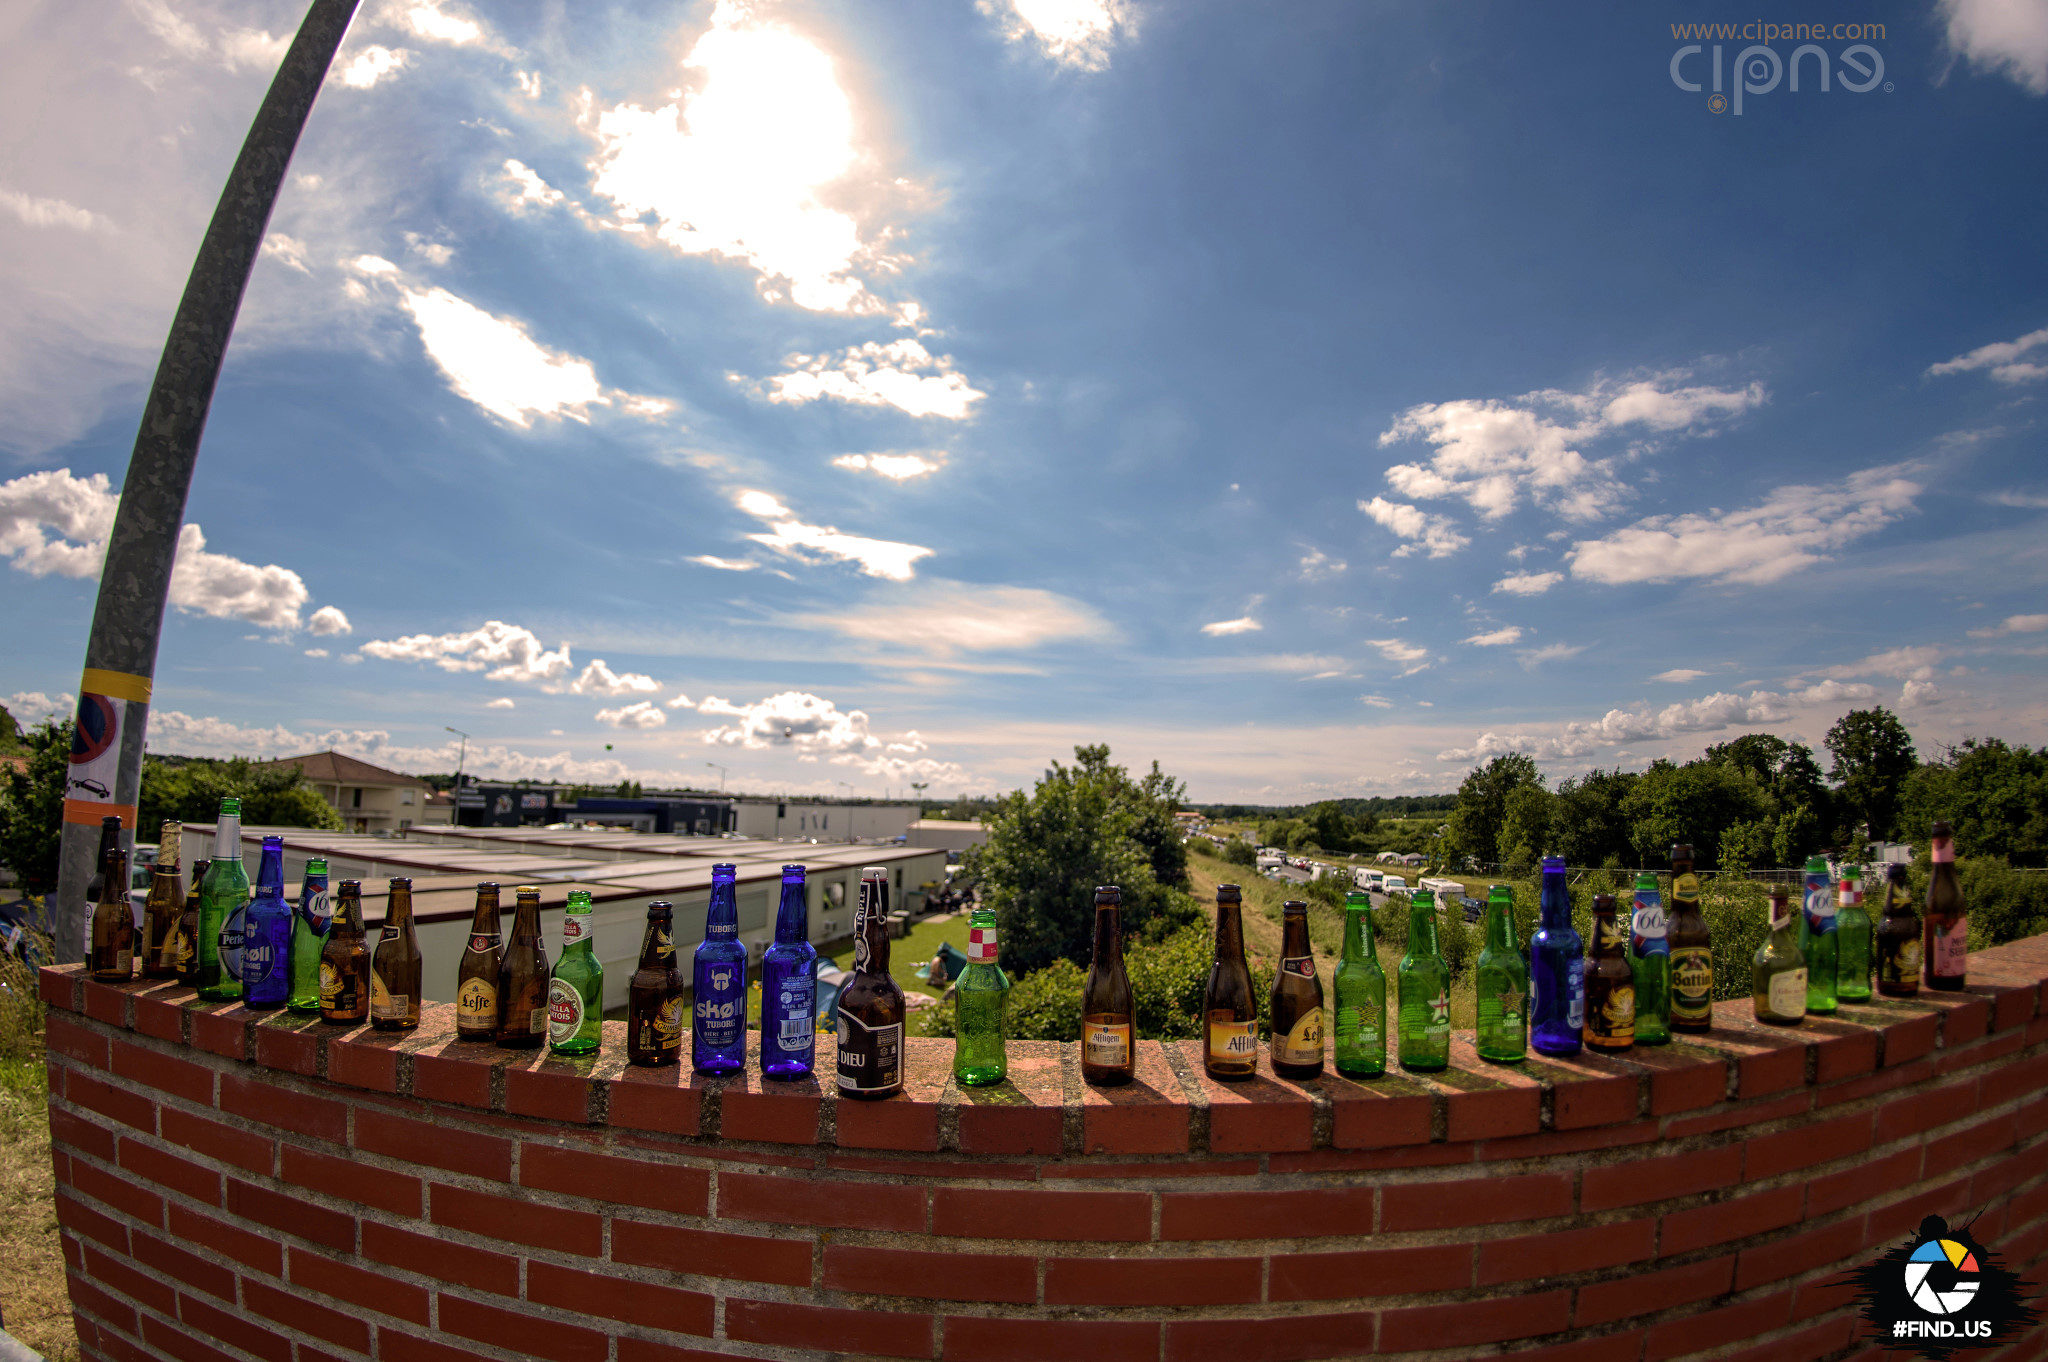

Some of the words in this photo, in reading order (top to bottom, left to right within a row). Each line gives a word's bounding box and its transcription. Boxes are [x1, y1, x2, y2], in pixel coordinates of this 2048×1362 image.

[855, 890, 866, 926] TRIPLE
[708, 924, 737, 933] TUBORG
[1503, 916, 1512, 948] Heineken
[1361, 924, 1369, 957] Heineken
[1429, 923, 1438, 955] Heineken
[1672, 970, 1711, 987] Battin
[462, 993, 491, 1013] Leffe
[696, 996, 743, 1019] skøll
[705, 1019, 736, 1029] TUBORG
[1092, 1033, 1120, 1044] Affligem
[840, 1050, 866, 1067] DIEU
